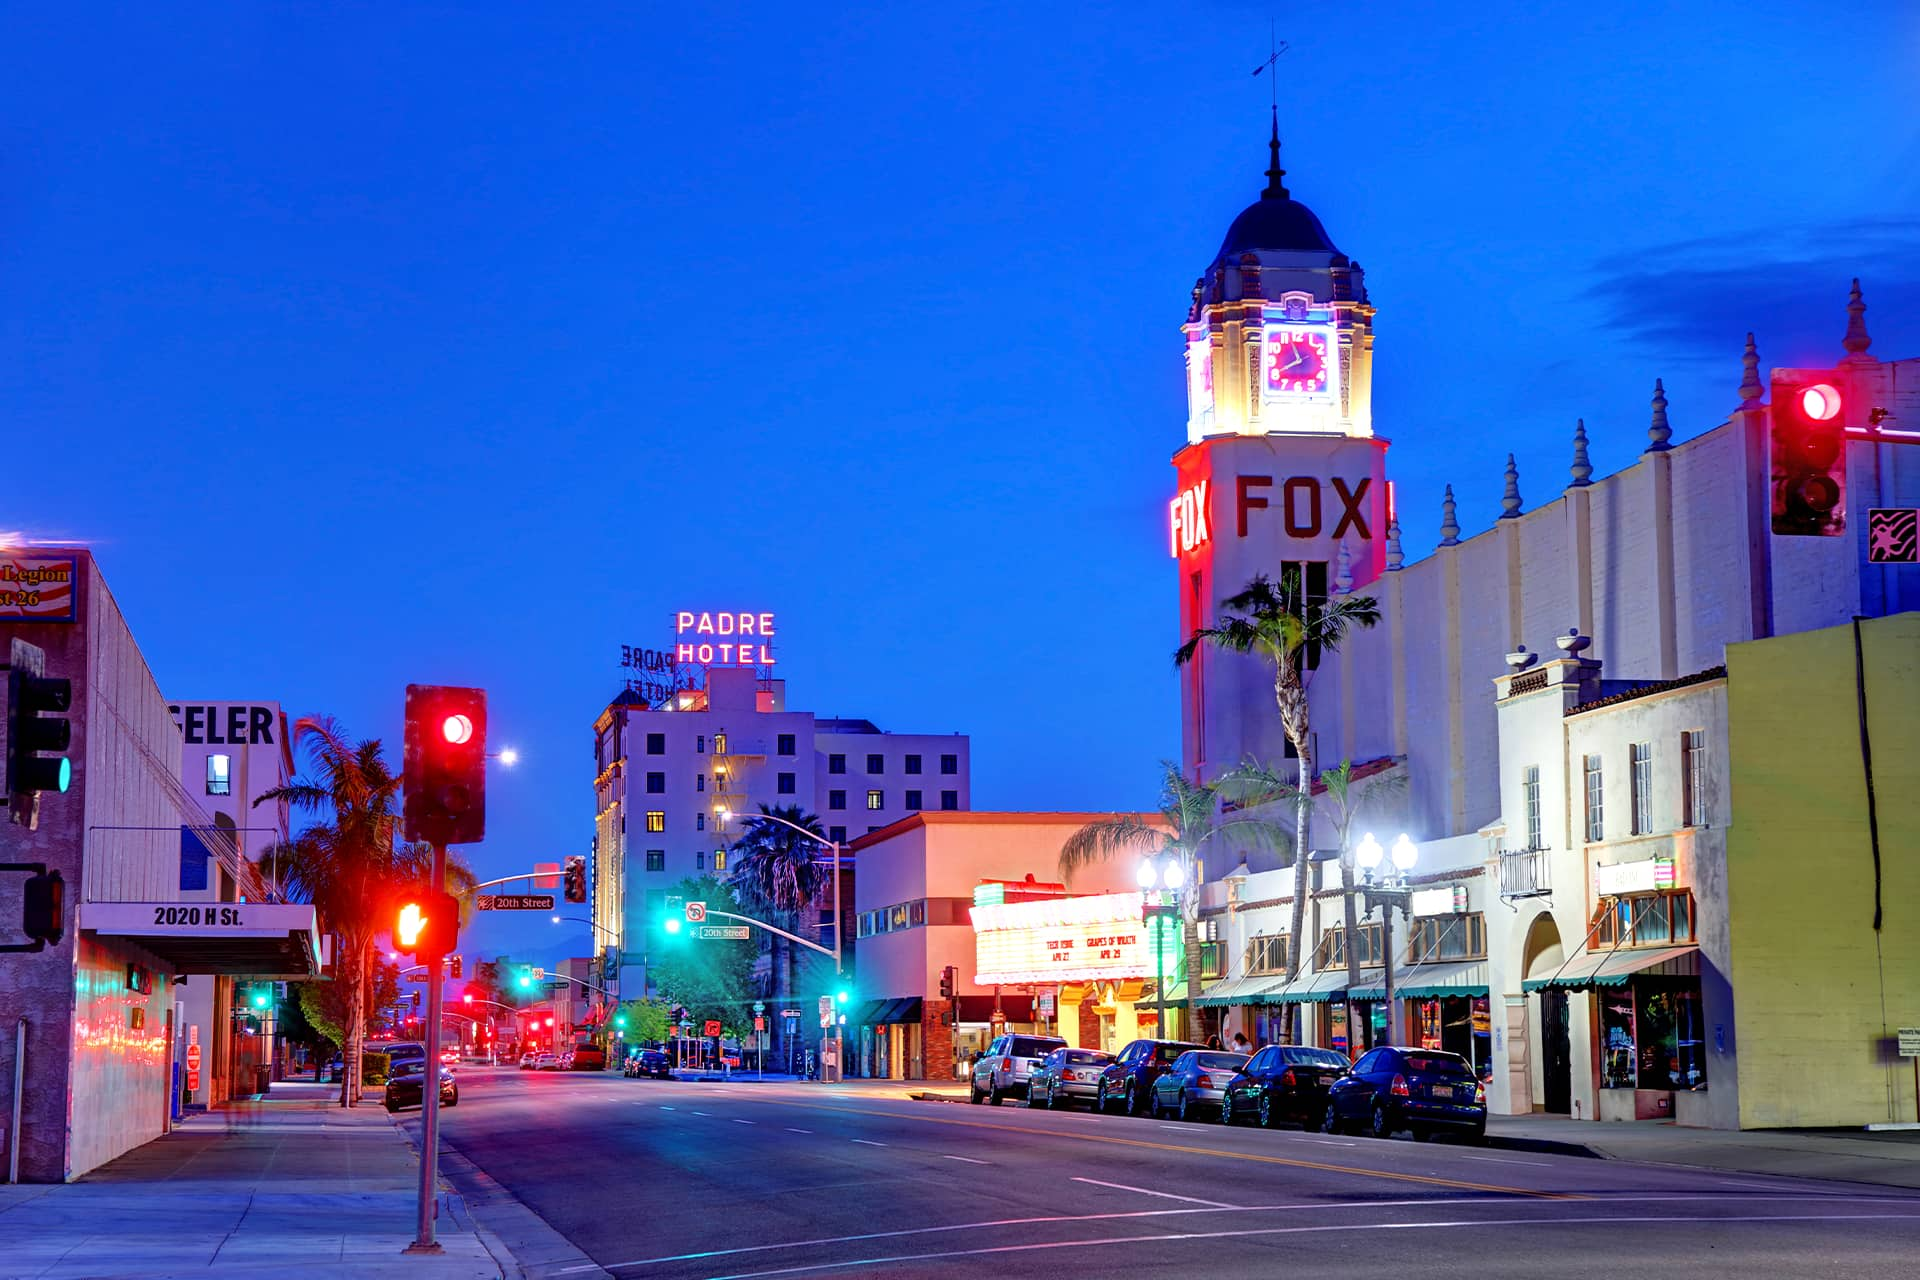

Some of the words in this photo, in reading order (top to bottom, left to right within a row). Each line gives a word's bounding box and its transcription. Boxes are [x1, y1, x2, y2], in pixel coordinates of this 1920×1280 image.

[1268, 342, 1281, 354] 10
[1316, 343, 1325, 355] 2
[1268, 355, 1277, 367] 9
[1320, 356, 1328, 368] 3
[1271, 368, 1280, 381] 8
[1316, 370, 1326, 382] 4
[1280, 378, 1289, 390] 7
[1294, 381, 1303, 393] 6
[1307, 379, 1316, 391] 5
[1236, 475, 1373, 540] FOX
[1170, 479, 1209, 559] FOX
[3, 565, 69, 585] Legion
[16, 589, 40, 607] 26
[676, 612, 775, 636] PADRE
[676, 643, 775, 664] HOTEL
[496, 898, 519, 908] 20th
[522, 898, 551, 908] Street
[154, 907, 200, 925] 2020
[204, 907, 217, 926] H
[220, 908, 243, 926] St.
[703, 928, 721, 937] 20th
[723, 928, 746, 937] Street
[1087, 937, 1107, 947] GRAPES
[1109, 937, 1115, 945] OF
[1117, 935, 1136, 945] WRATH
